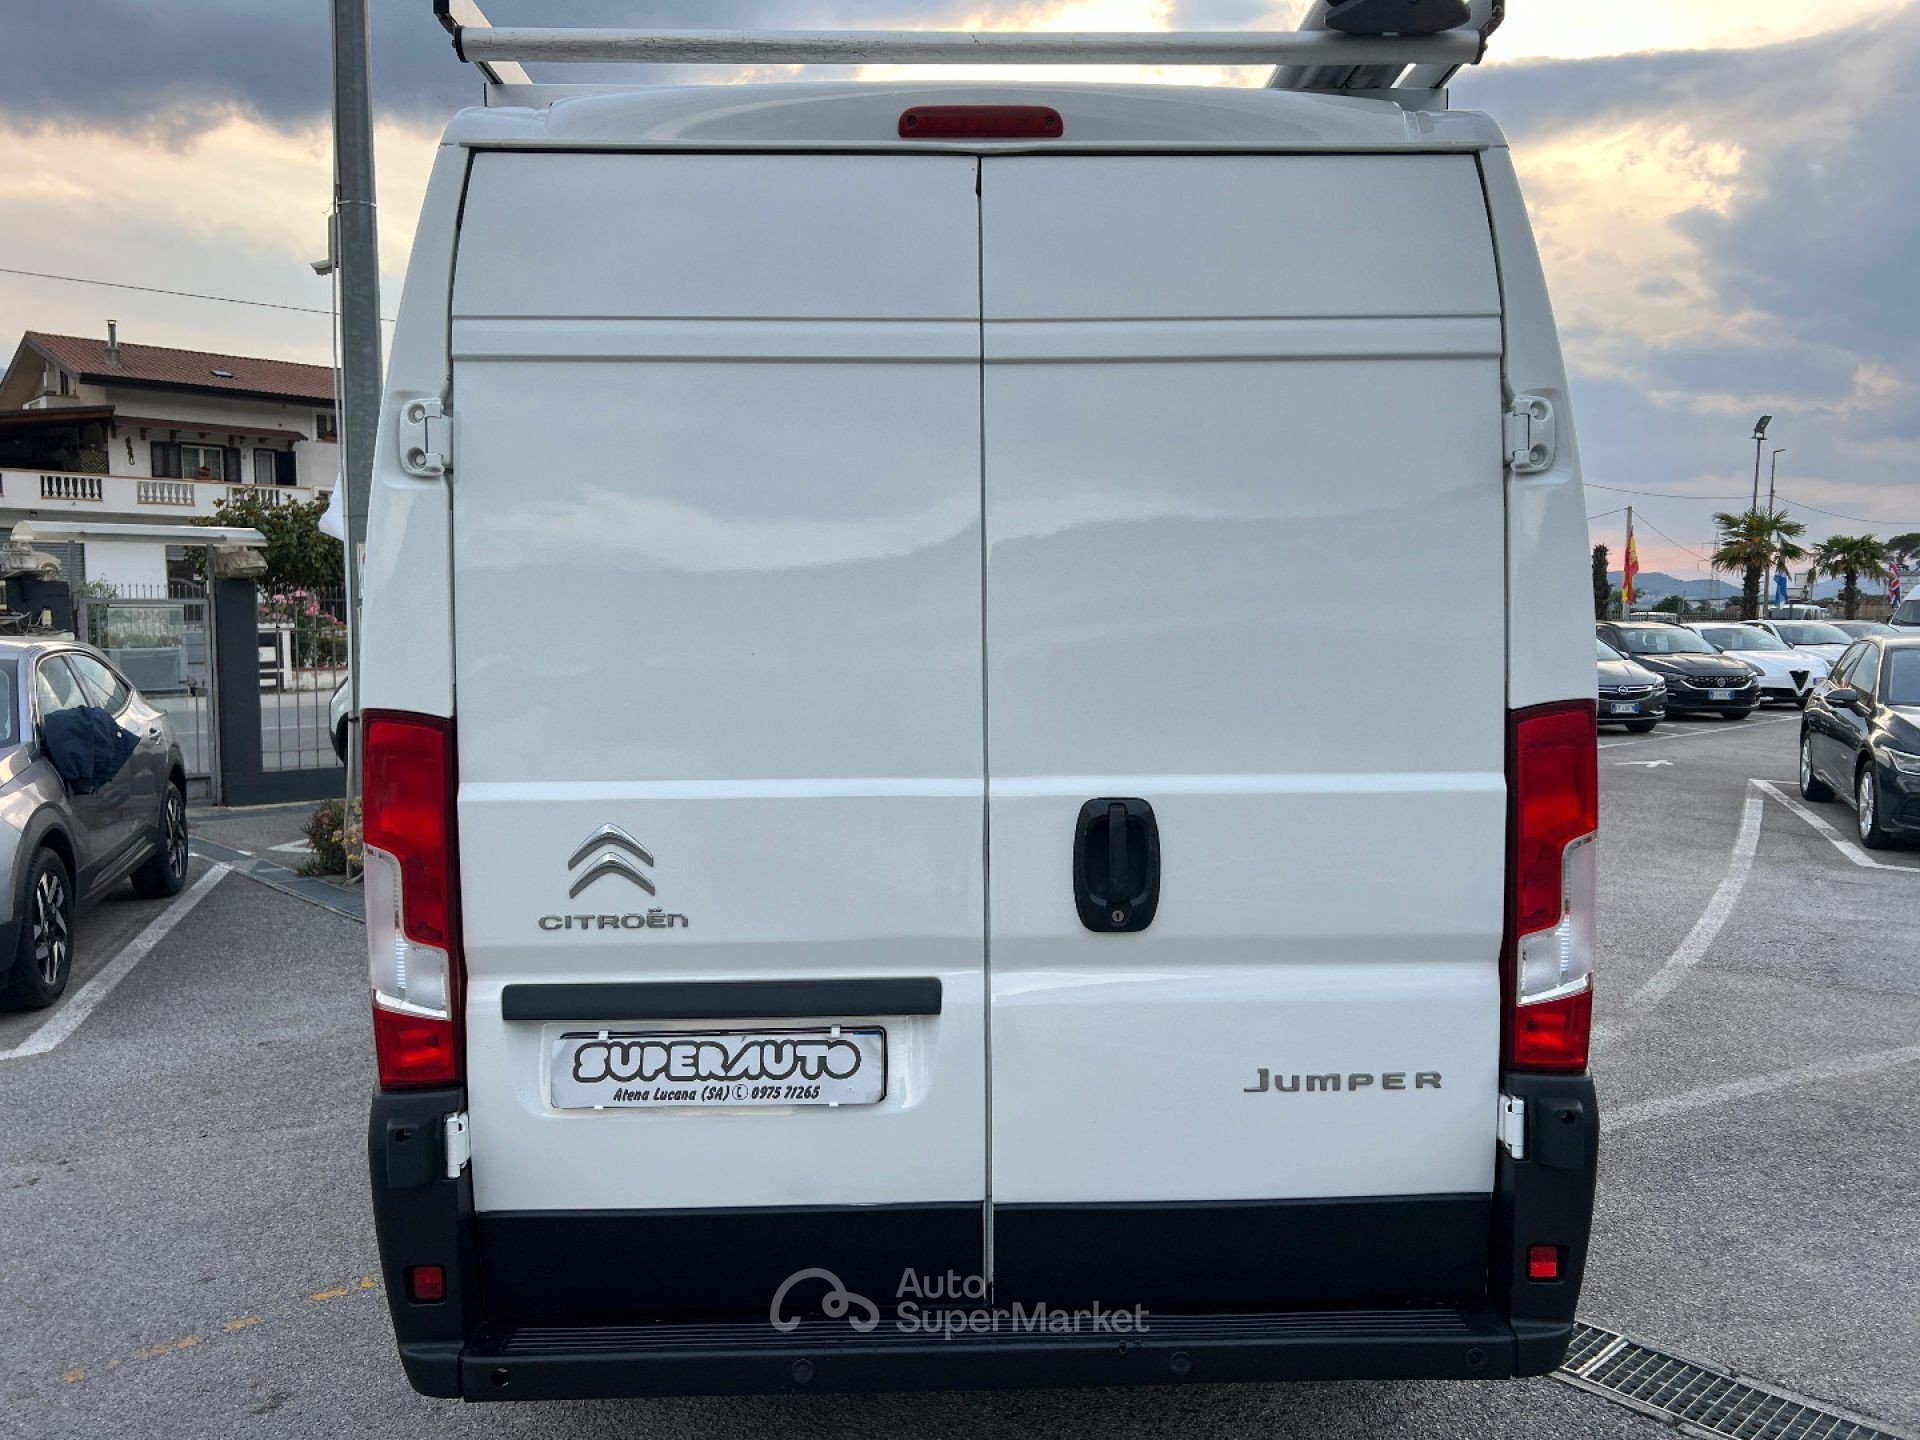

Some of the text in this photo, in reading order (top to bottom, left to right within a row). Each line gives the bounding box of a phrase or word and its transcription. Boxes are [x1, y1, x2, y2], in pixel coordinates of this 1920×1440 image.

[572, 1039, 862, 1083] SUPERAUTO
[613, 1085, 821, 1101] Atena Lucana (SA) 0975 71265
